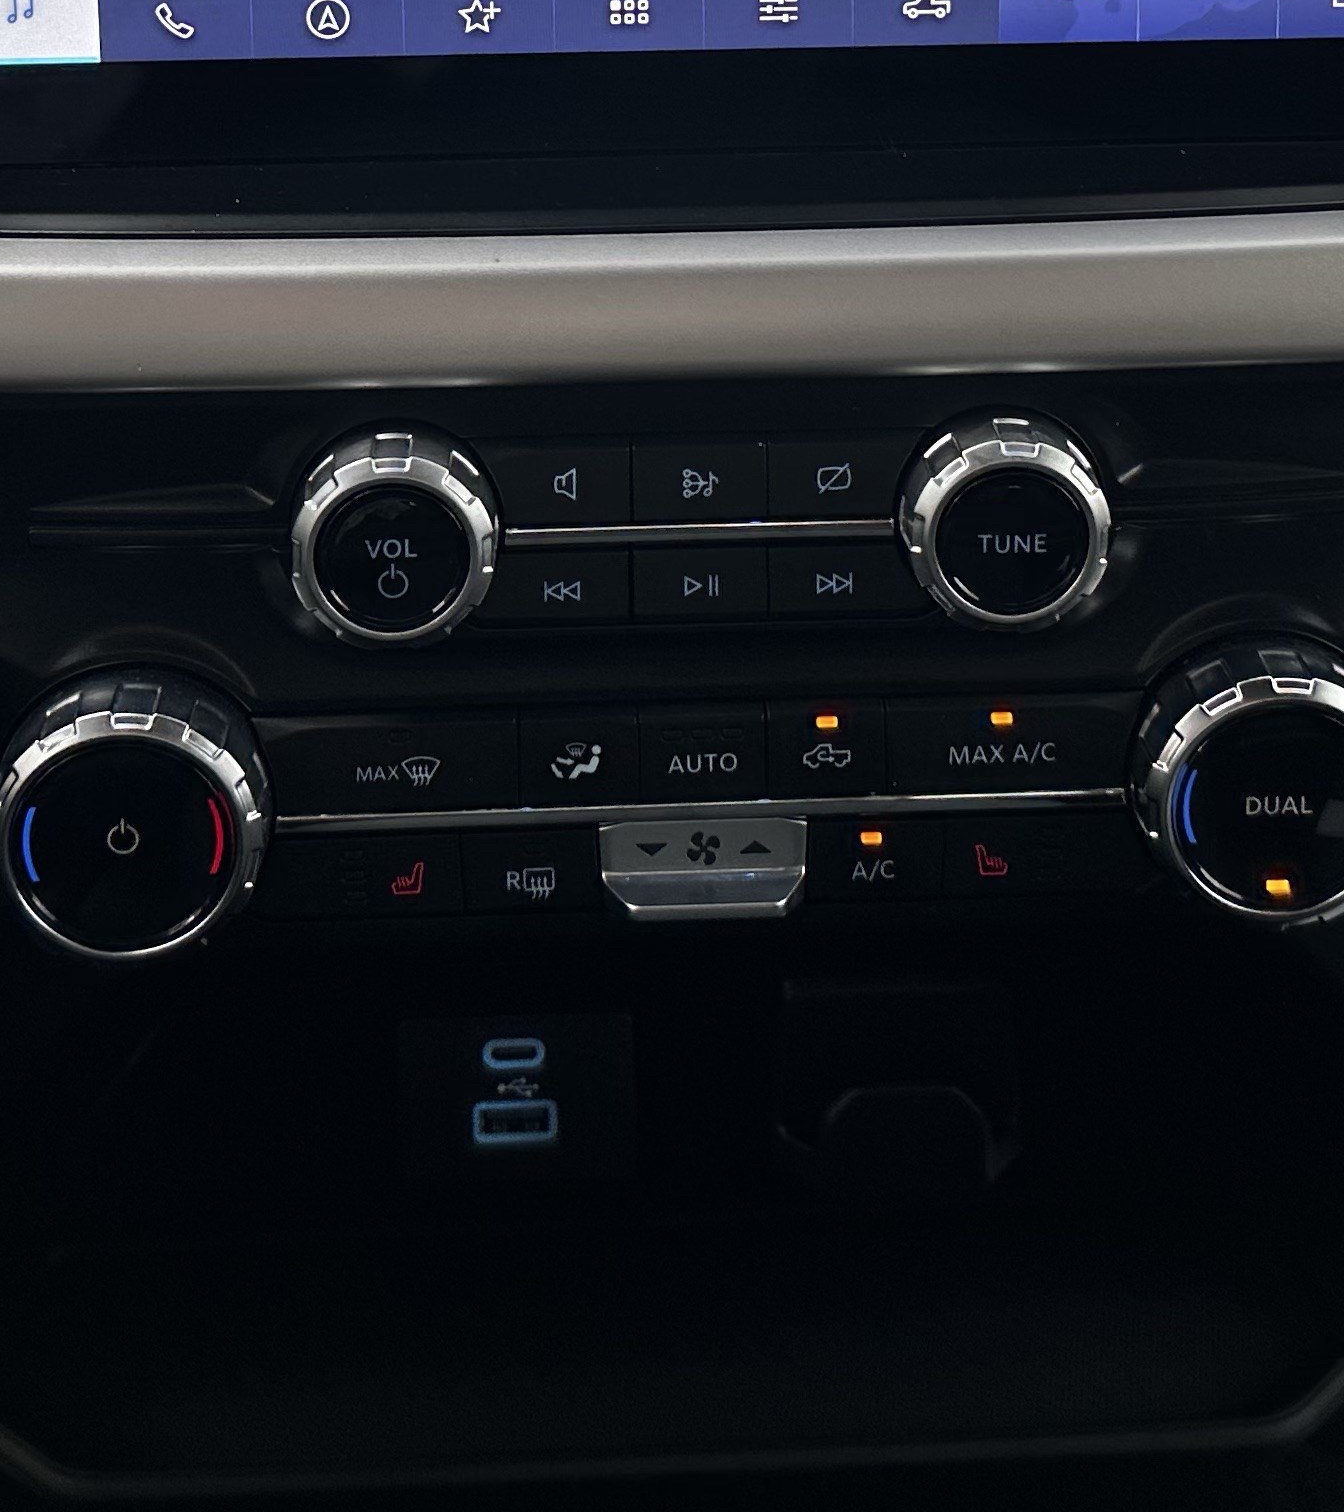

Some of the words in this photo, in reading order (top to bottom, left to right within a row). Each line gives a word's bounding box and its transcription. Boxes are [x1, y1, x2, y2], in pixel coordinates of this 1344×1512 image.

[366, 539, 417, 559] VOL
[977, 534, 1047, 554] TUNE
[949, 744, 1005, 765] MAX
[1012, 742, 1056, 764] A/C
[668, 753, 738, 775] AUTO
[356, 766, 399, 783] MAX
[1246, 796, 1313, 816] DUAL
[852, 859, 895, 882] A/C
